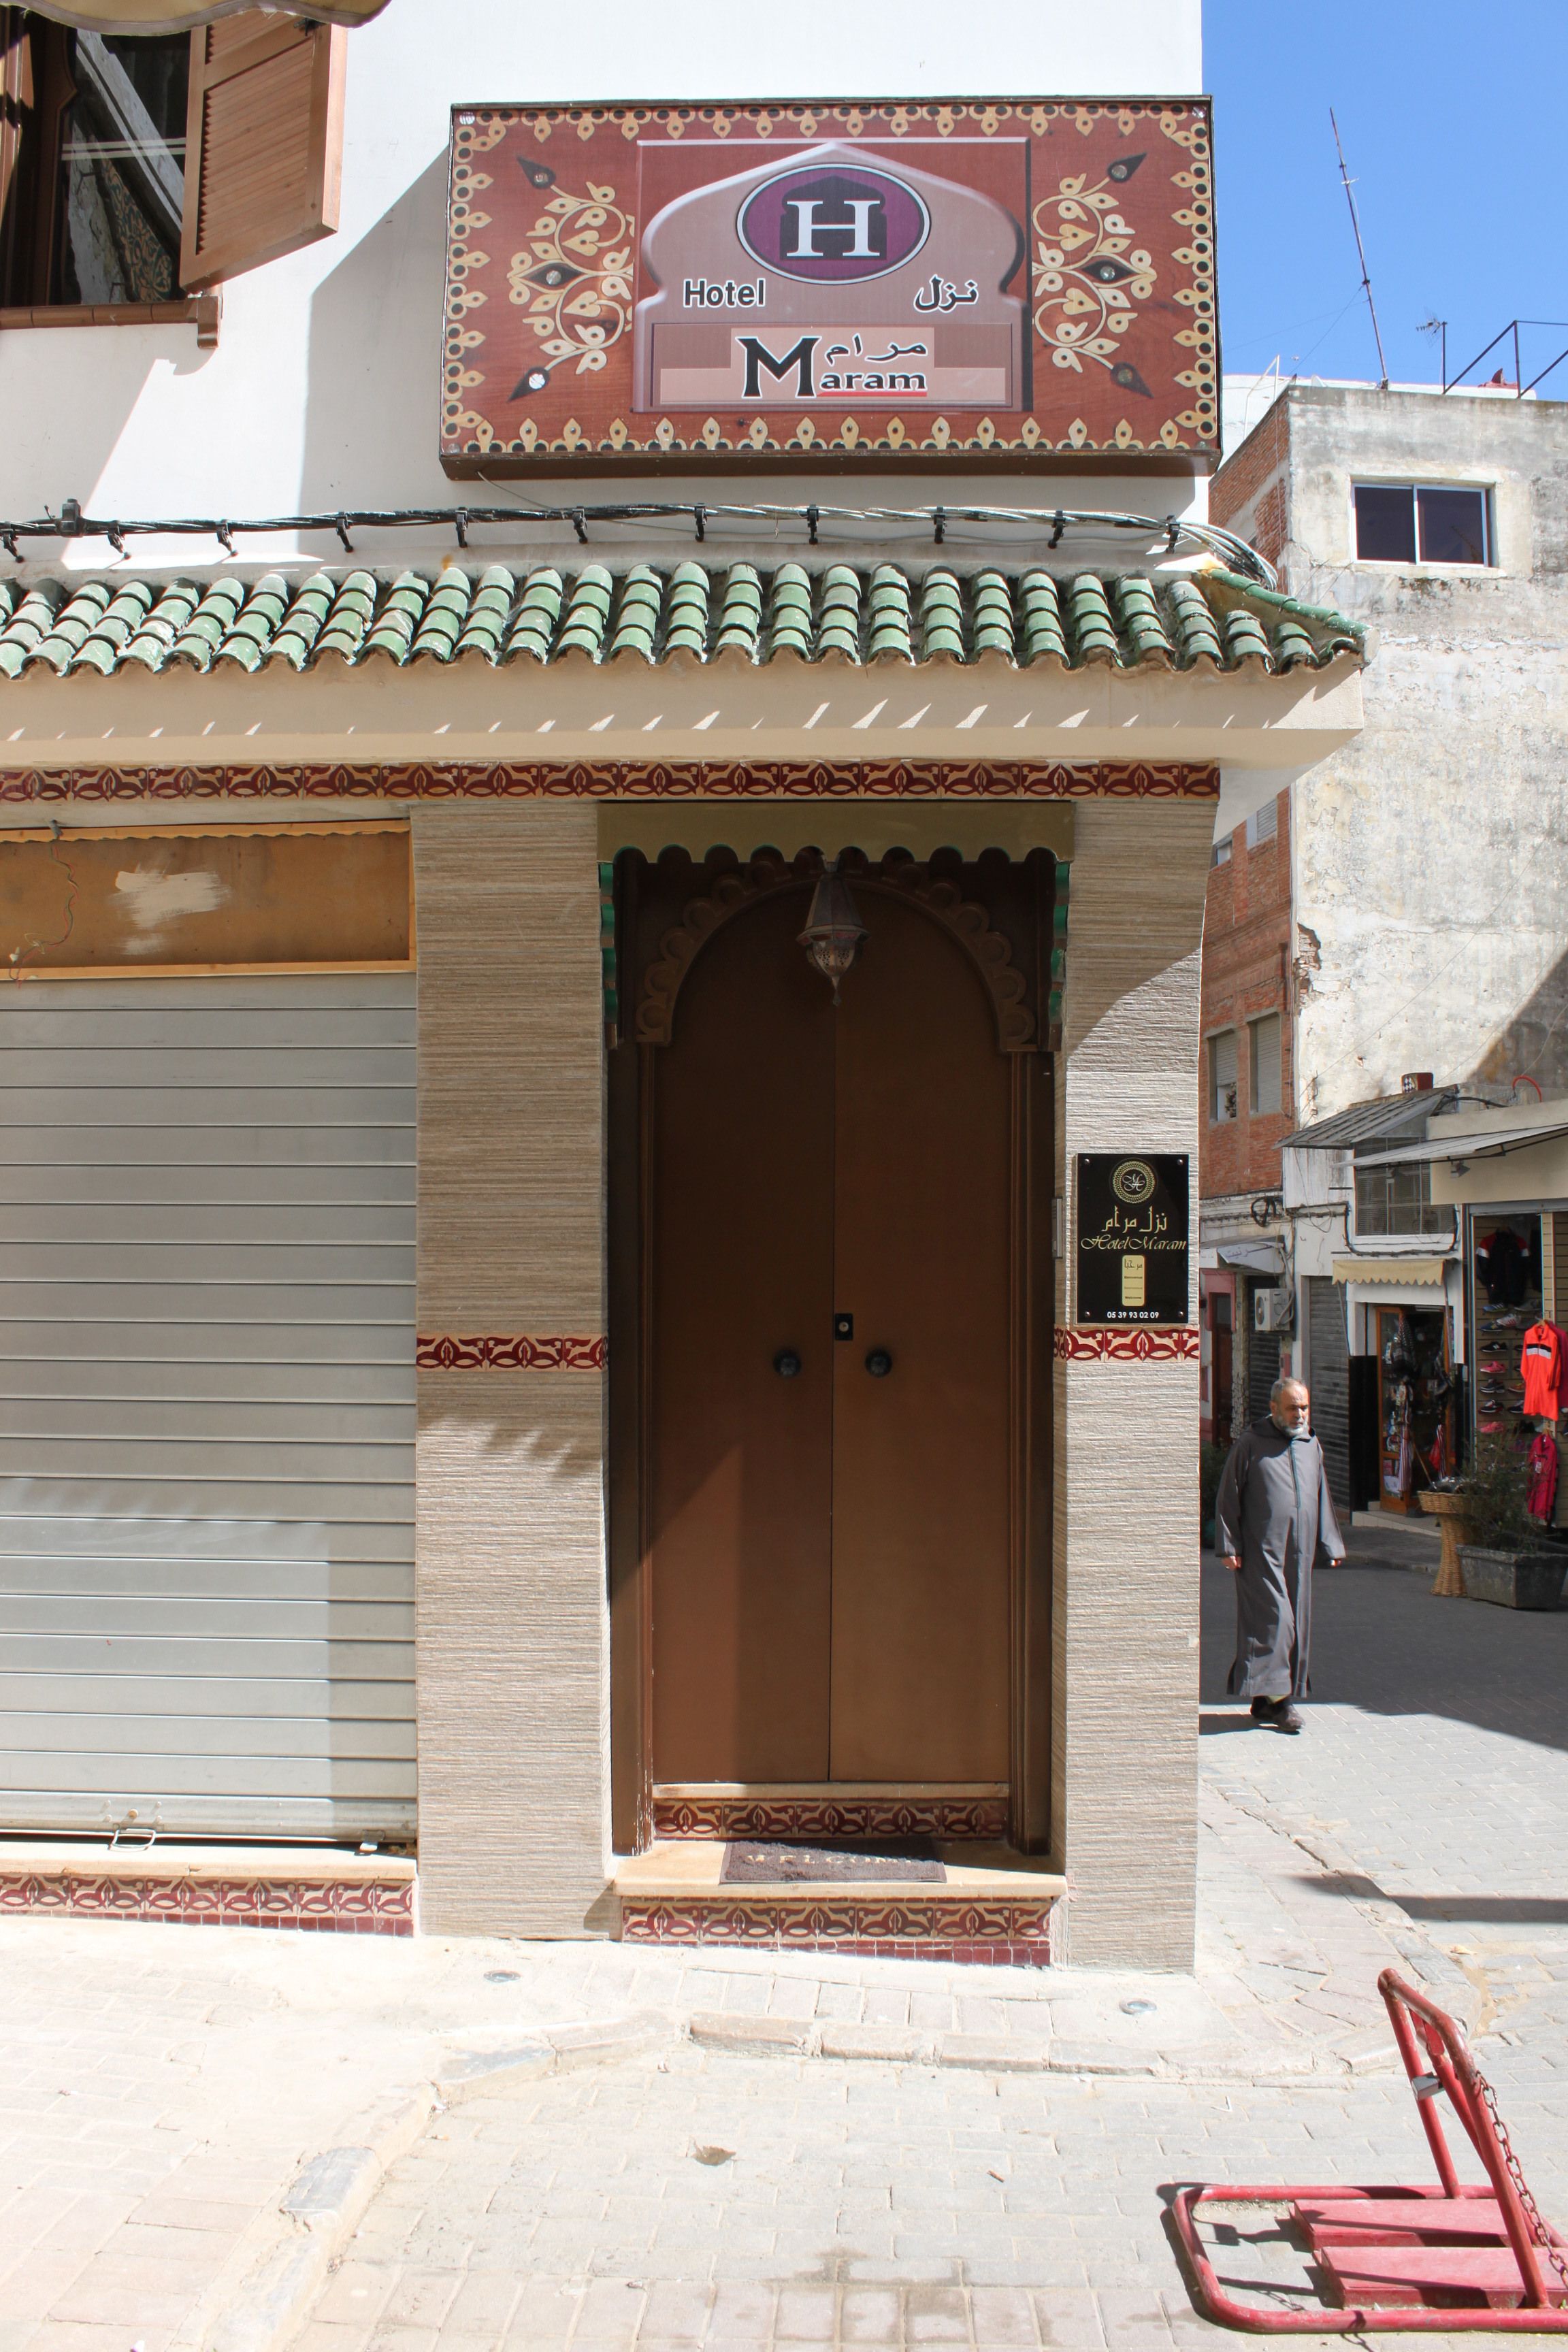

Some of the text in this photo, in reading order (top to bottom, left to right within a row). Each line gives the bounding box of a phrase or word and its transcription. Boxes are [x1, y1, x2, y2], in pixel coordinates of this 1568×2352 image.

[787, 199, 880, 257] H
[684, 278, 765, 308] Hotel
[913, 274, 978, 312] نزل
[825, 333, 928, 366] مرام
[735, 336, 928, 398] Maram
[1139, 1205, 1168, 1233] نزل
[1081, 1234, 1186, 1250] Hotel Maram
